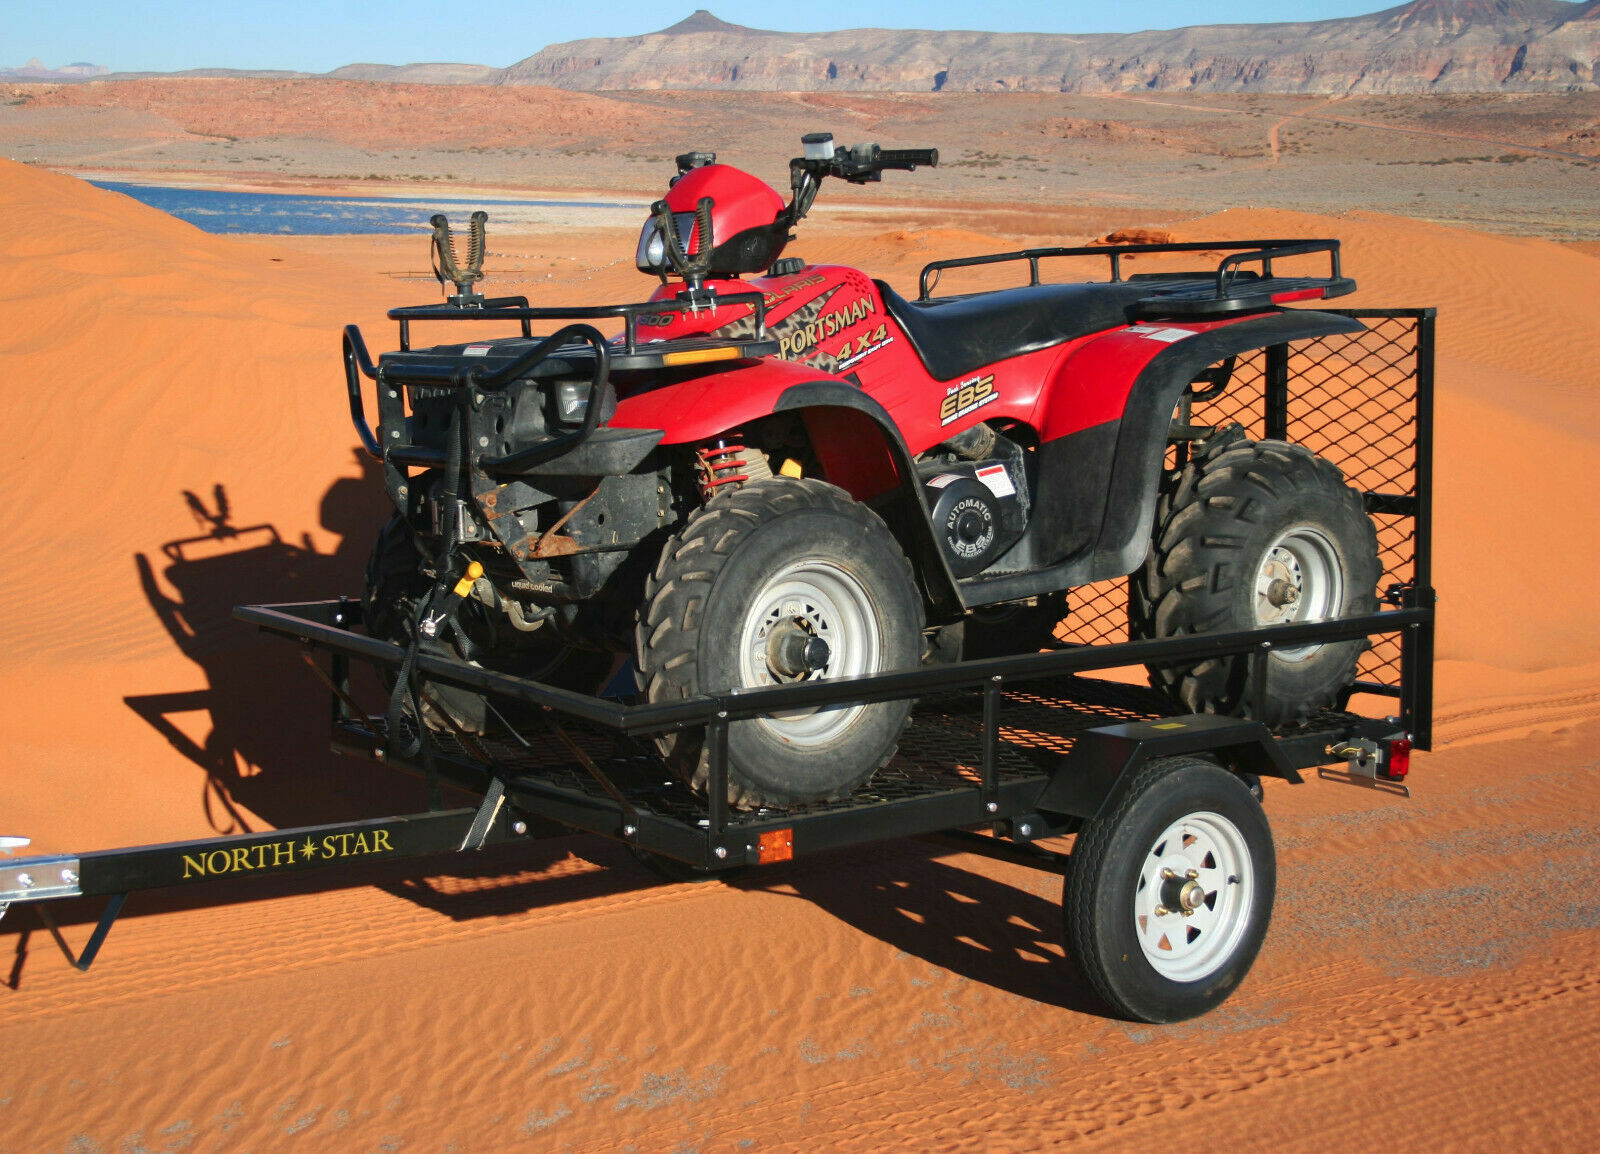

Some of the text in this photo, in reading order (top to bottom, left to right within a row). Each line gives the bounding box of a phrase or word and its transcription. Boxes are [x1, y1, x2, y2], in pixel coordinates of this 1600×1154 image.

[940, 374, 995, 420] EBS
[947, 499, 992, 529] AUTOMATIC
[955, 535, 986, 554] EBS
[182, 829, 394, 879] NORTH STAR
